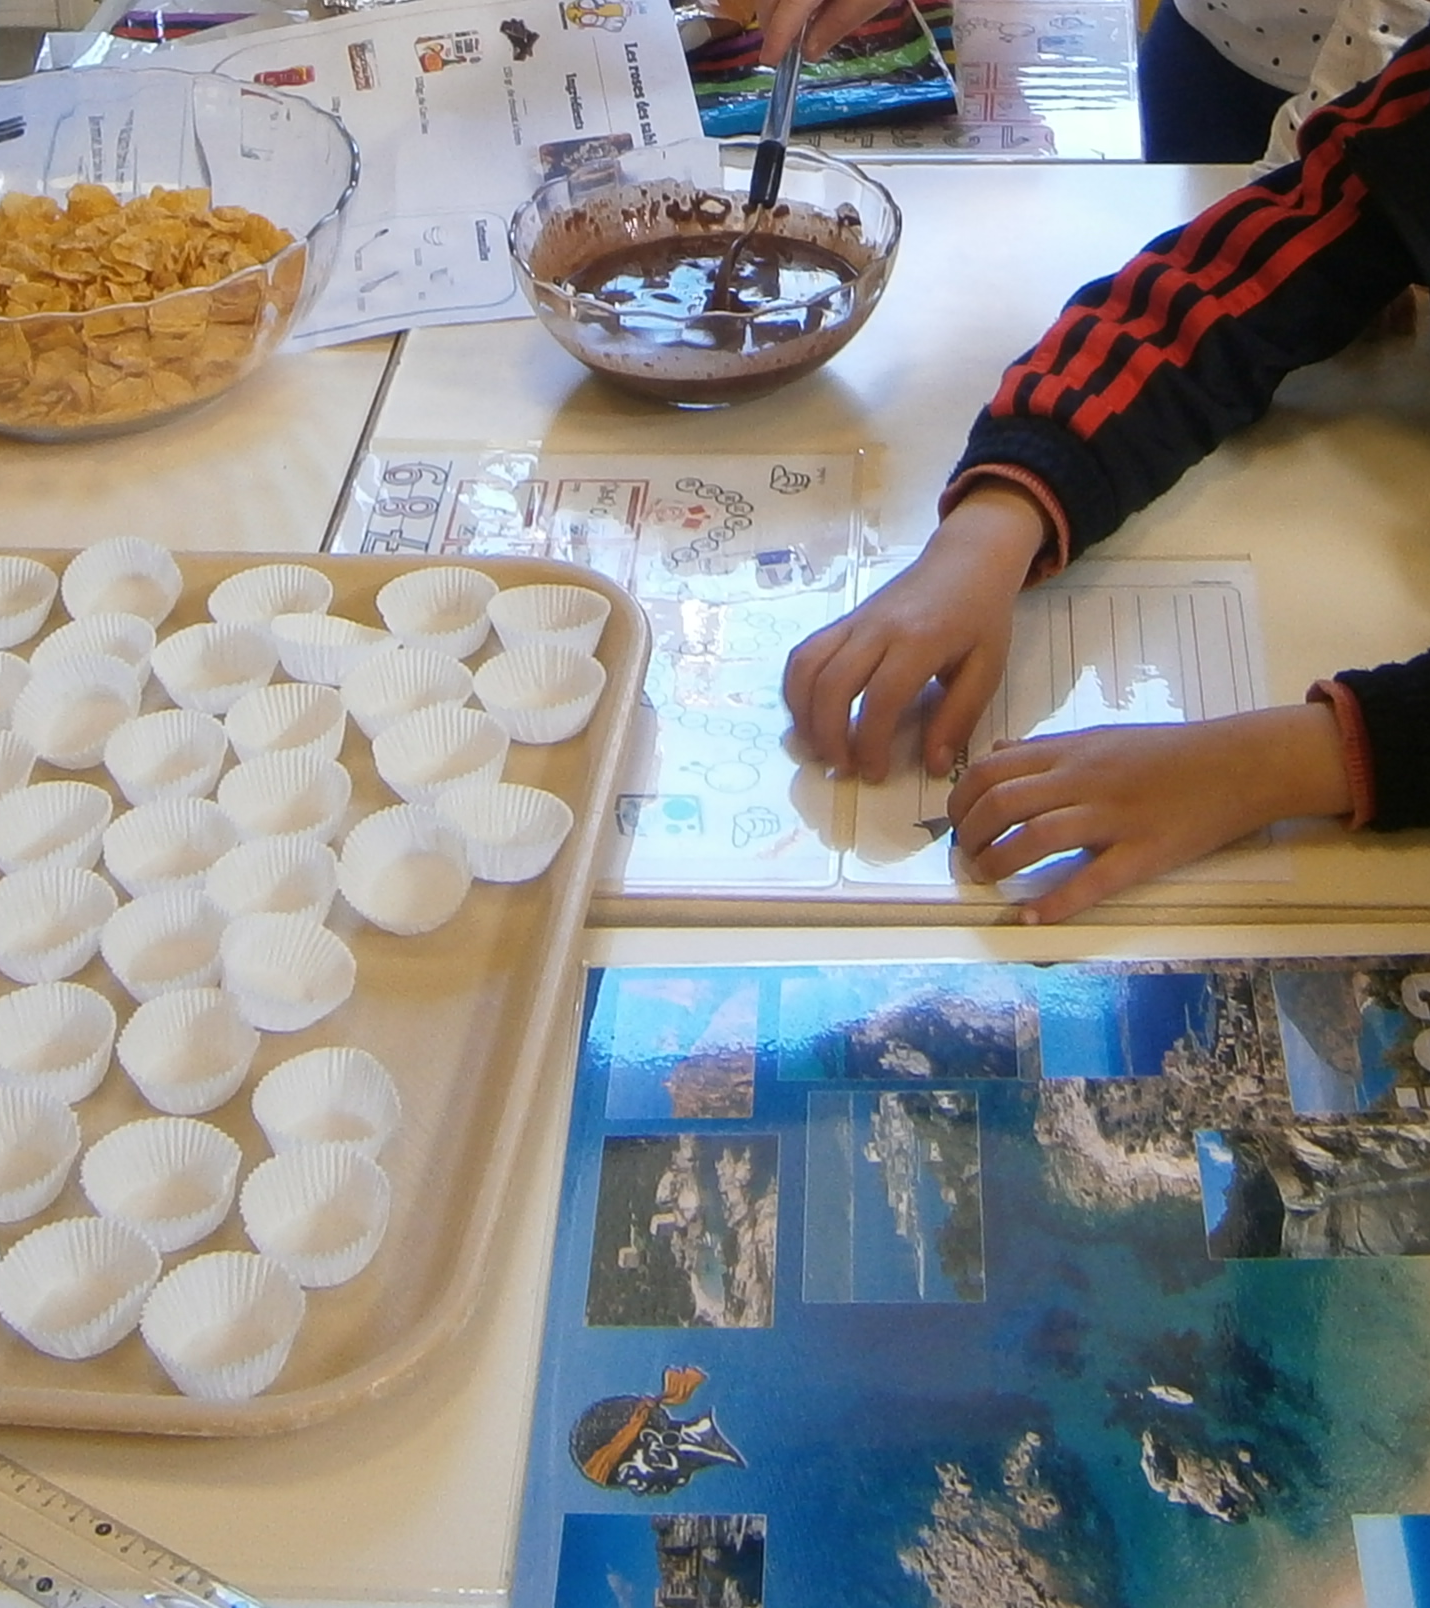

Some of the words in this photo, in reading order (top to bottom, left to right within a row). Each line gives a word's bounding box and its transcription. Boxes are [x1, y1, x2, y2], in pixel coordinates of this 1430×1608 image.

[624, 42, 639, 63] Les
[628, 64, 645, 100] roses
[565, 73, 585, 130] Ingrédients
[636, 101, 650, 121] des
[640, 122, 658, 146] sabl
[1001, 125, 1030, 149] 1
[383, 462, 449, 487] 9
[373, 496, 440, 520] 8
